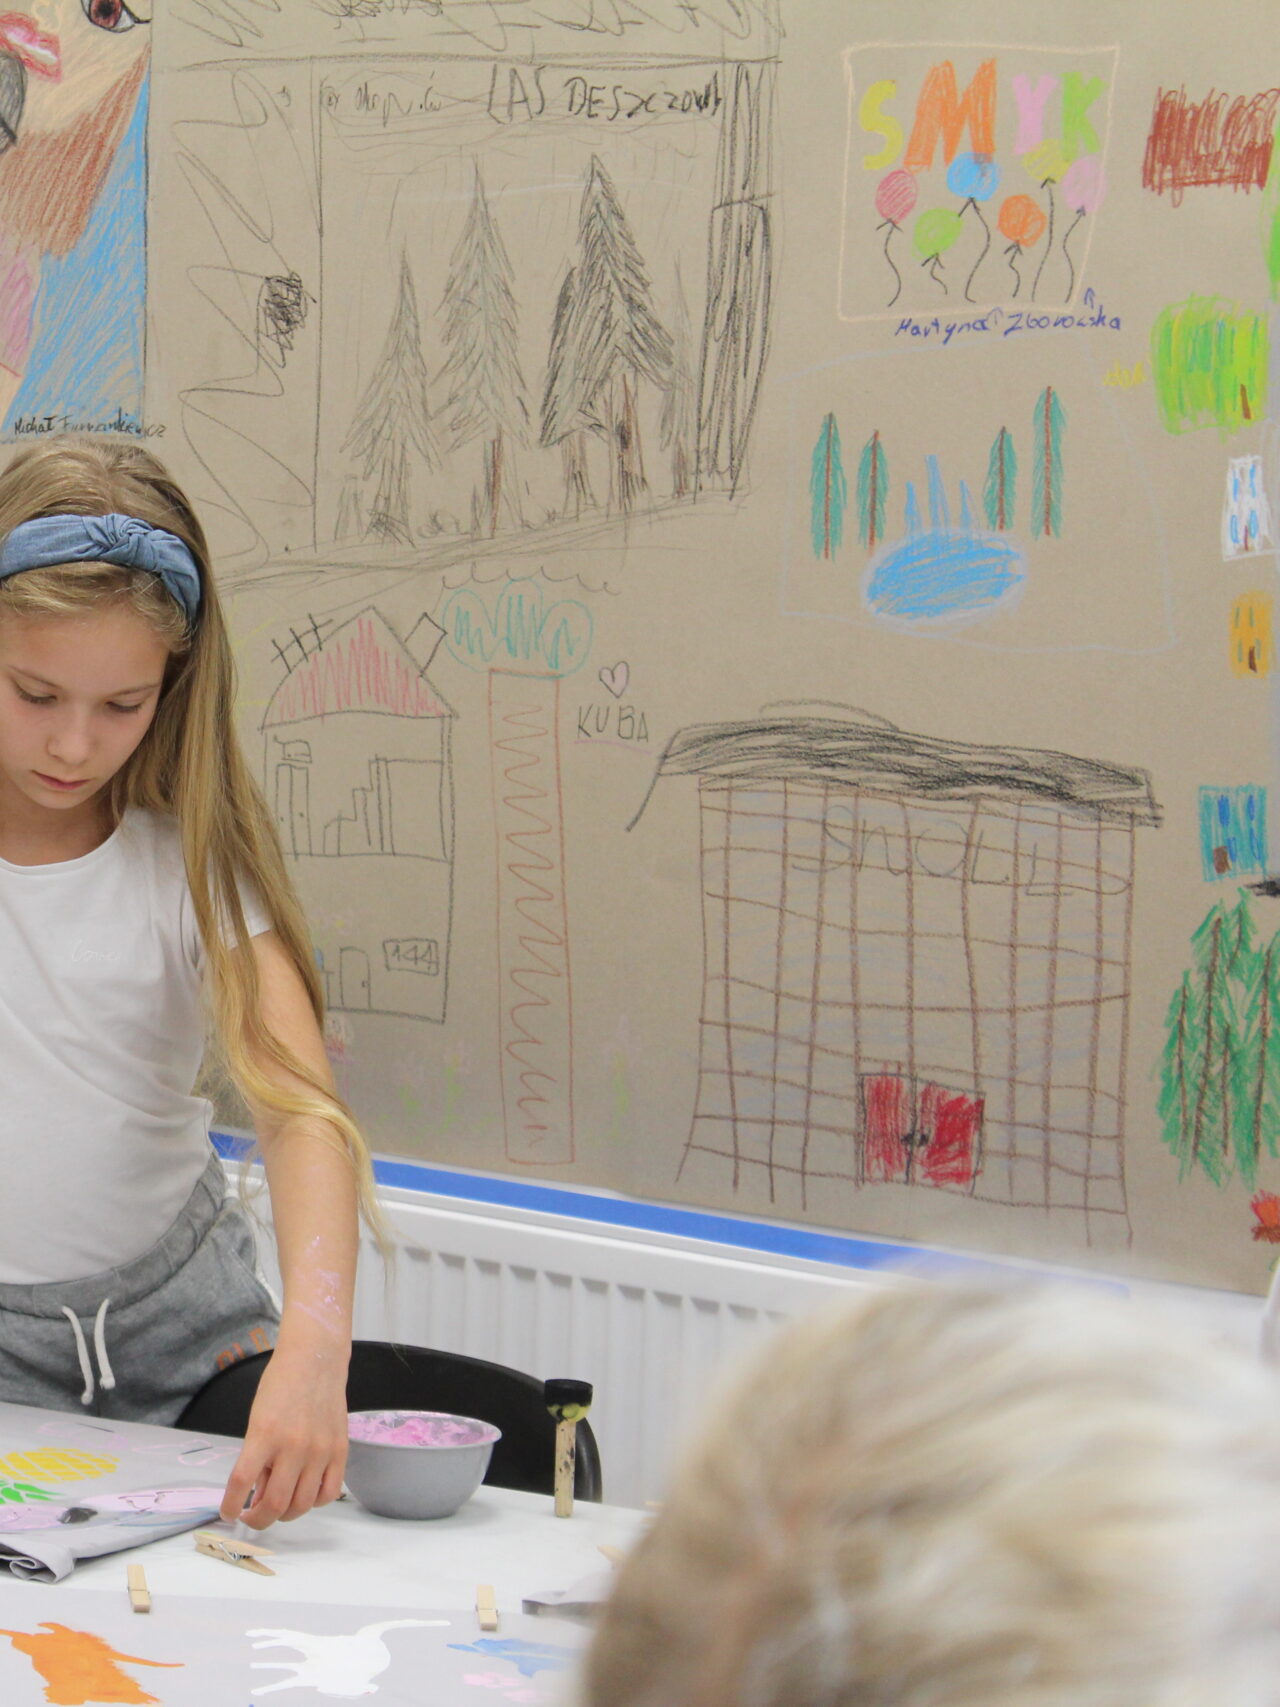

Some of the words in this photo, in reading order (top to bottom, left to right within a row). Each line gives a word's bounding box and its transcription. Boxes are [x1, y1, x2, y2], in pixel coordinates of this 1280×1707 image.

[487, 64, 547, 125] LAS
[858, 58, 1106, 172] SMYK
[578, 703, 649, 743] KUBA
